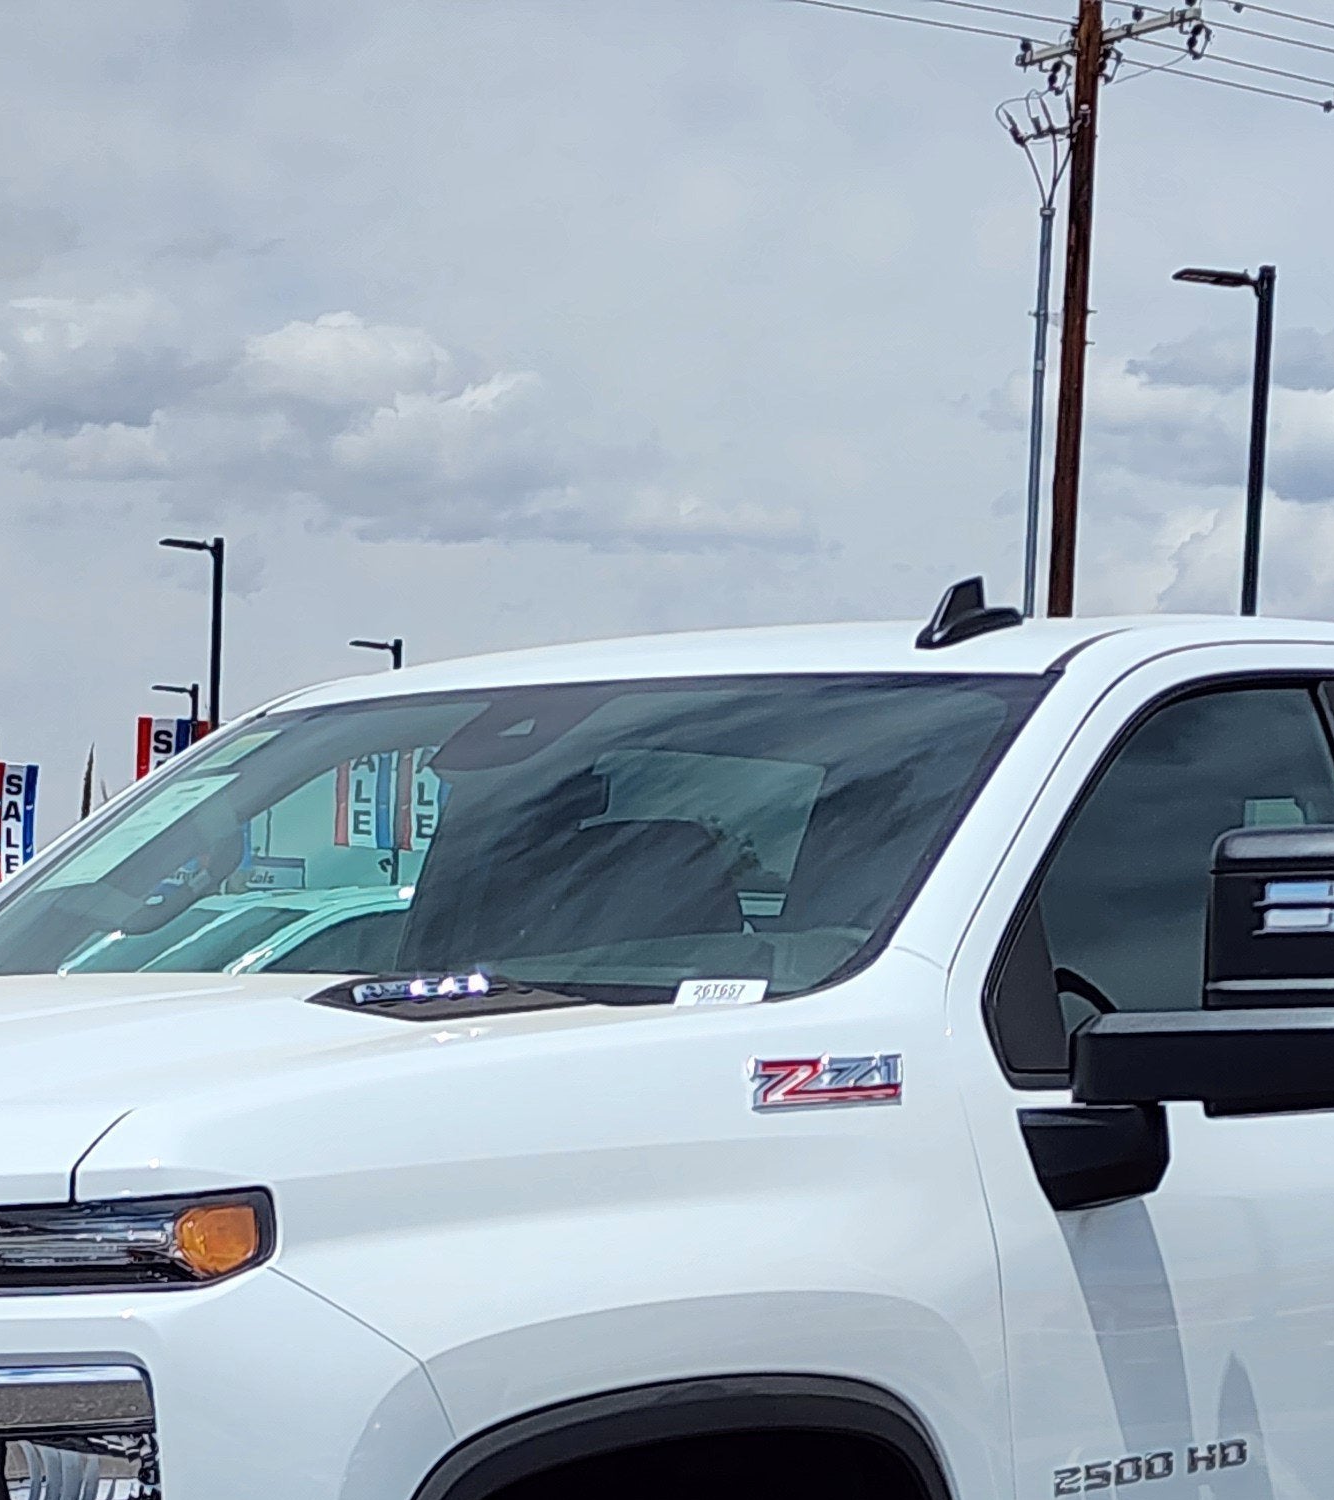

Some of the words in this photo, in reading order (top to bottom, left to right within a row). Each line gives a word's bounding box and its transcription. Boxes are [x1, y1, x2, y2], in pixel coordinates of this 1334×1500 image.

[2, 774, 23, 874] SALE
[352, 754, 376, 836] ALE
[749, 1052, 902, 1110] Z71
[1054, 1451, 1174, 1498] 2500
[1187, 1438, 1248, 1475] HD
